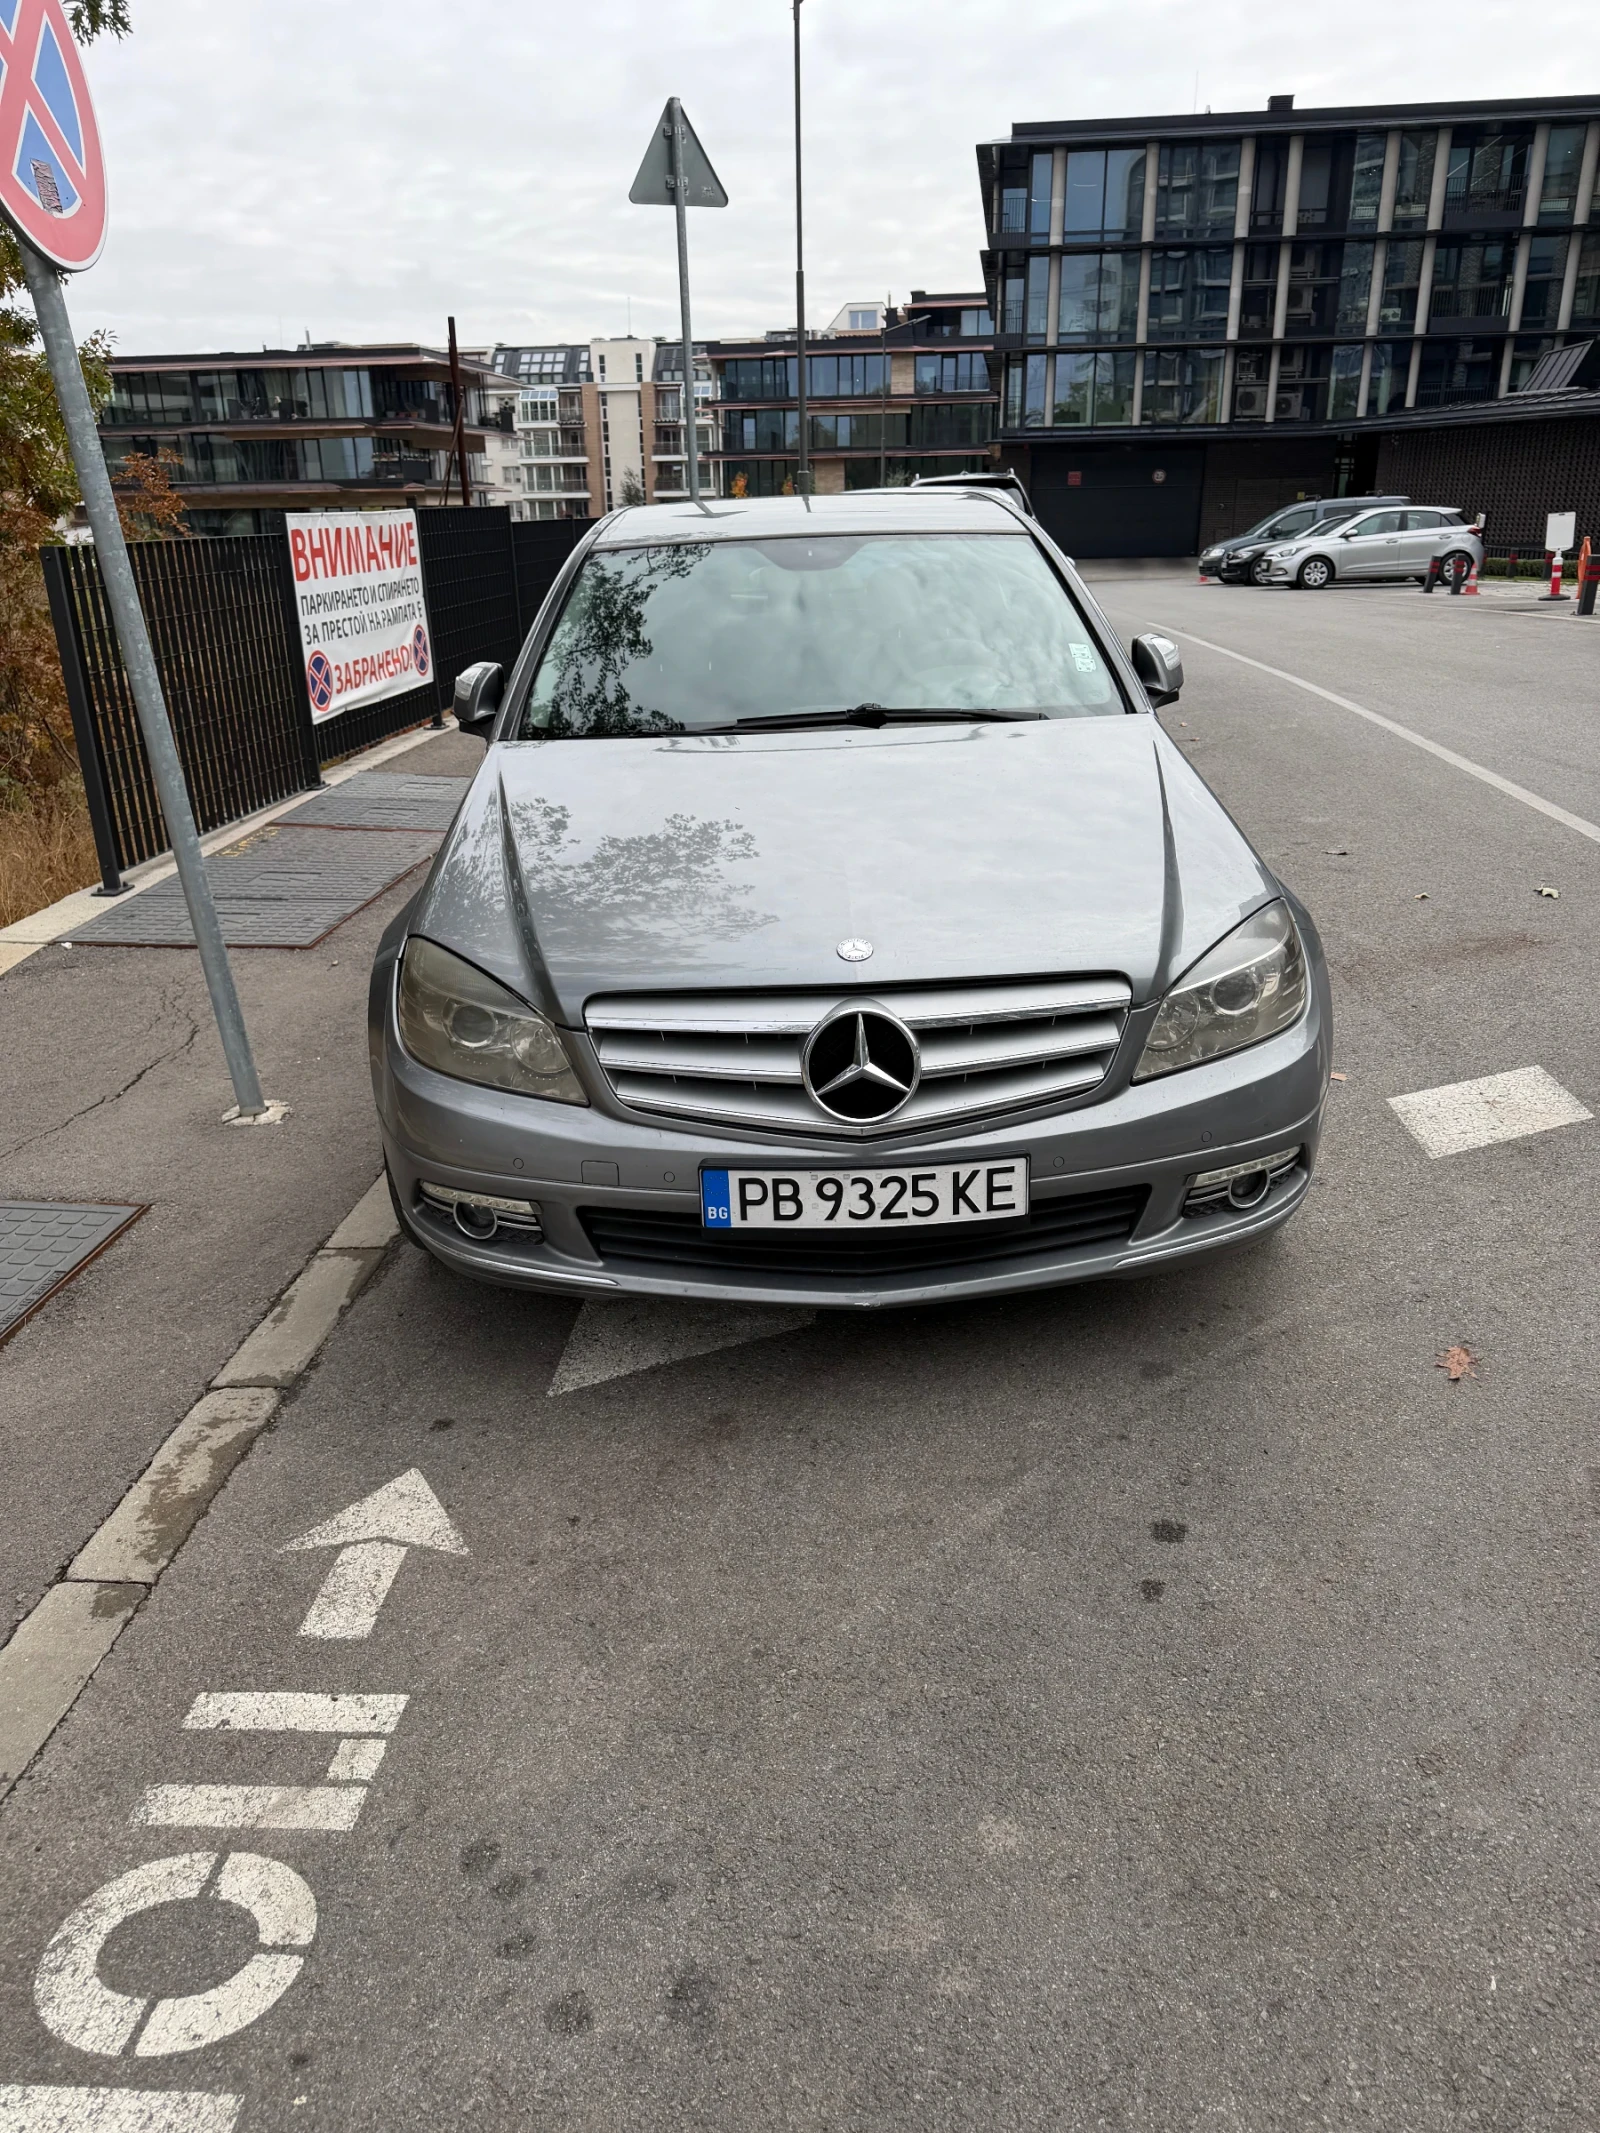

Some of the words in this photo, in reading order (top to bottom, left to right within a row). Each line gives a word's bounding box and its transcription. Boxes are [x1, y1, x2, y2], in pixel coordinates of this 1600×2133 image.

[290, 522, 417, 582] ВНИМАНИЕ
[300, 586, 369, 616] ПАРКИРАНЕТО
[369, 585, 377, 604] И
[377, 577, 419, 603] СПИРАНЕТО
[304, 623, 320, 646] ЗА
[321, 611, 368, 642] ПРЕСТОЙ
[367, 611, 382, 632] НА
[381, 602, 417, 629] РАМПАТА
[417, 601, 423, 619] Е
[334, 643, 414, 695] ЗАБРАНЕНО!
[707, 1206, 729, 1220] BG
[738, 1177, 803, 1221] PB
[815, 1172, 940, 1221] 9325
[951, 1166, 1017, 1216] KE
